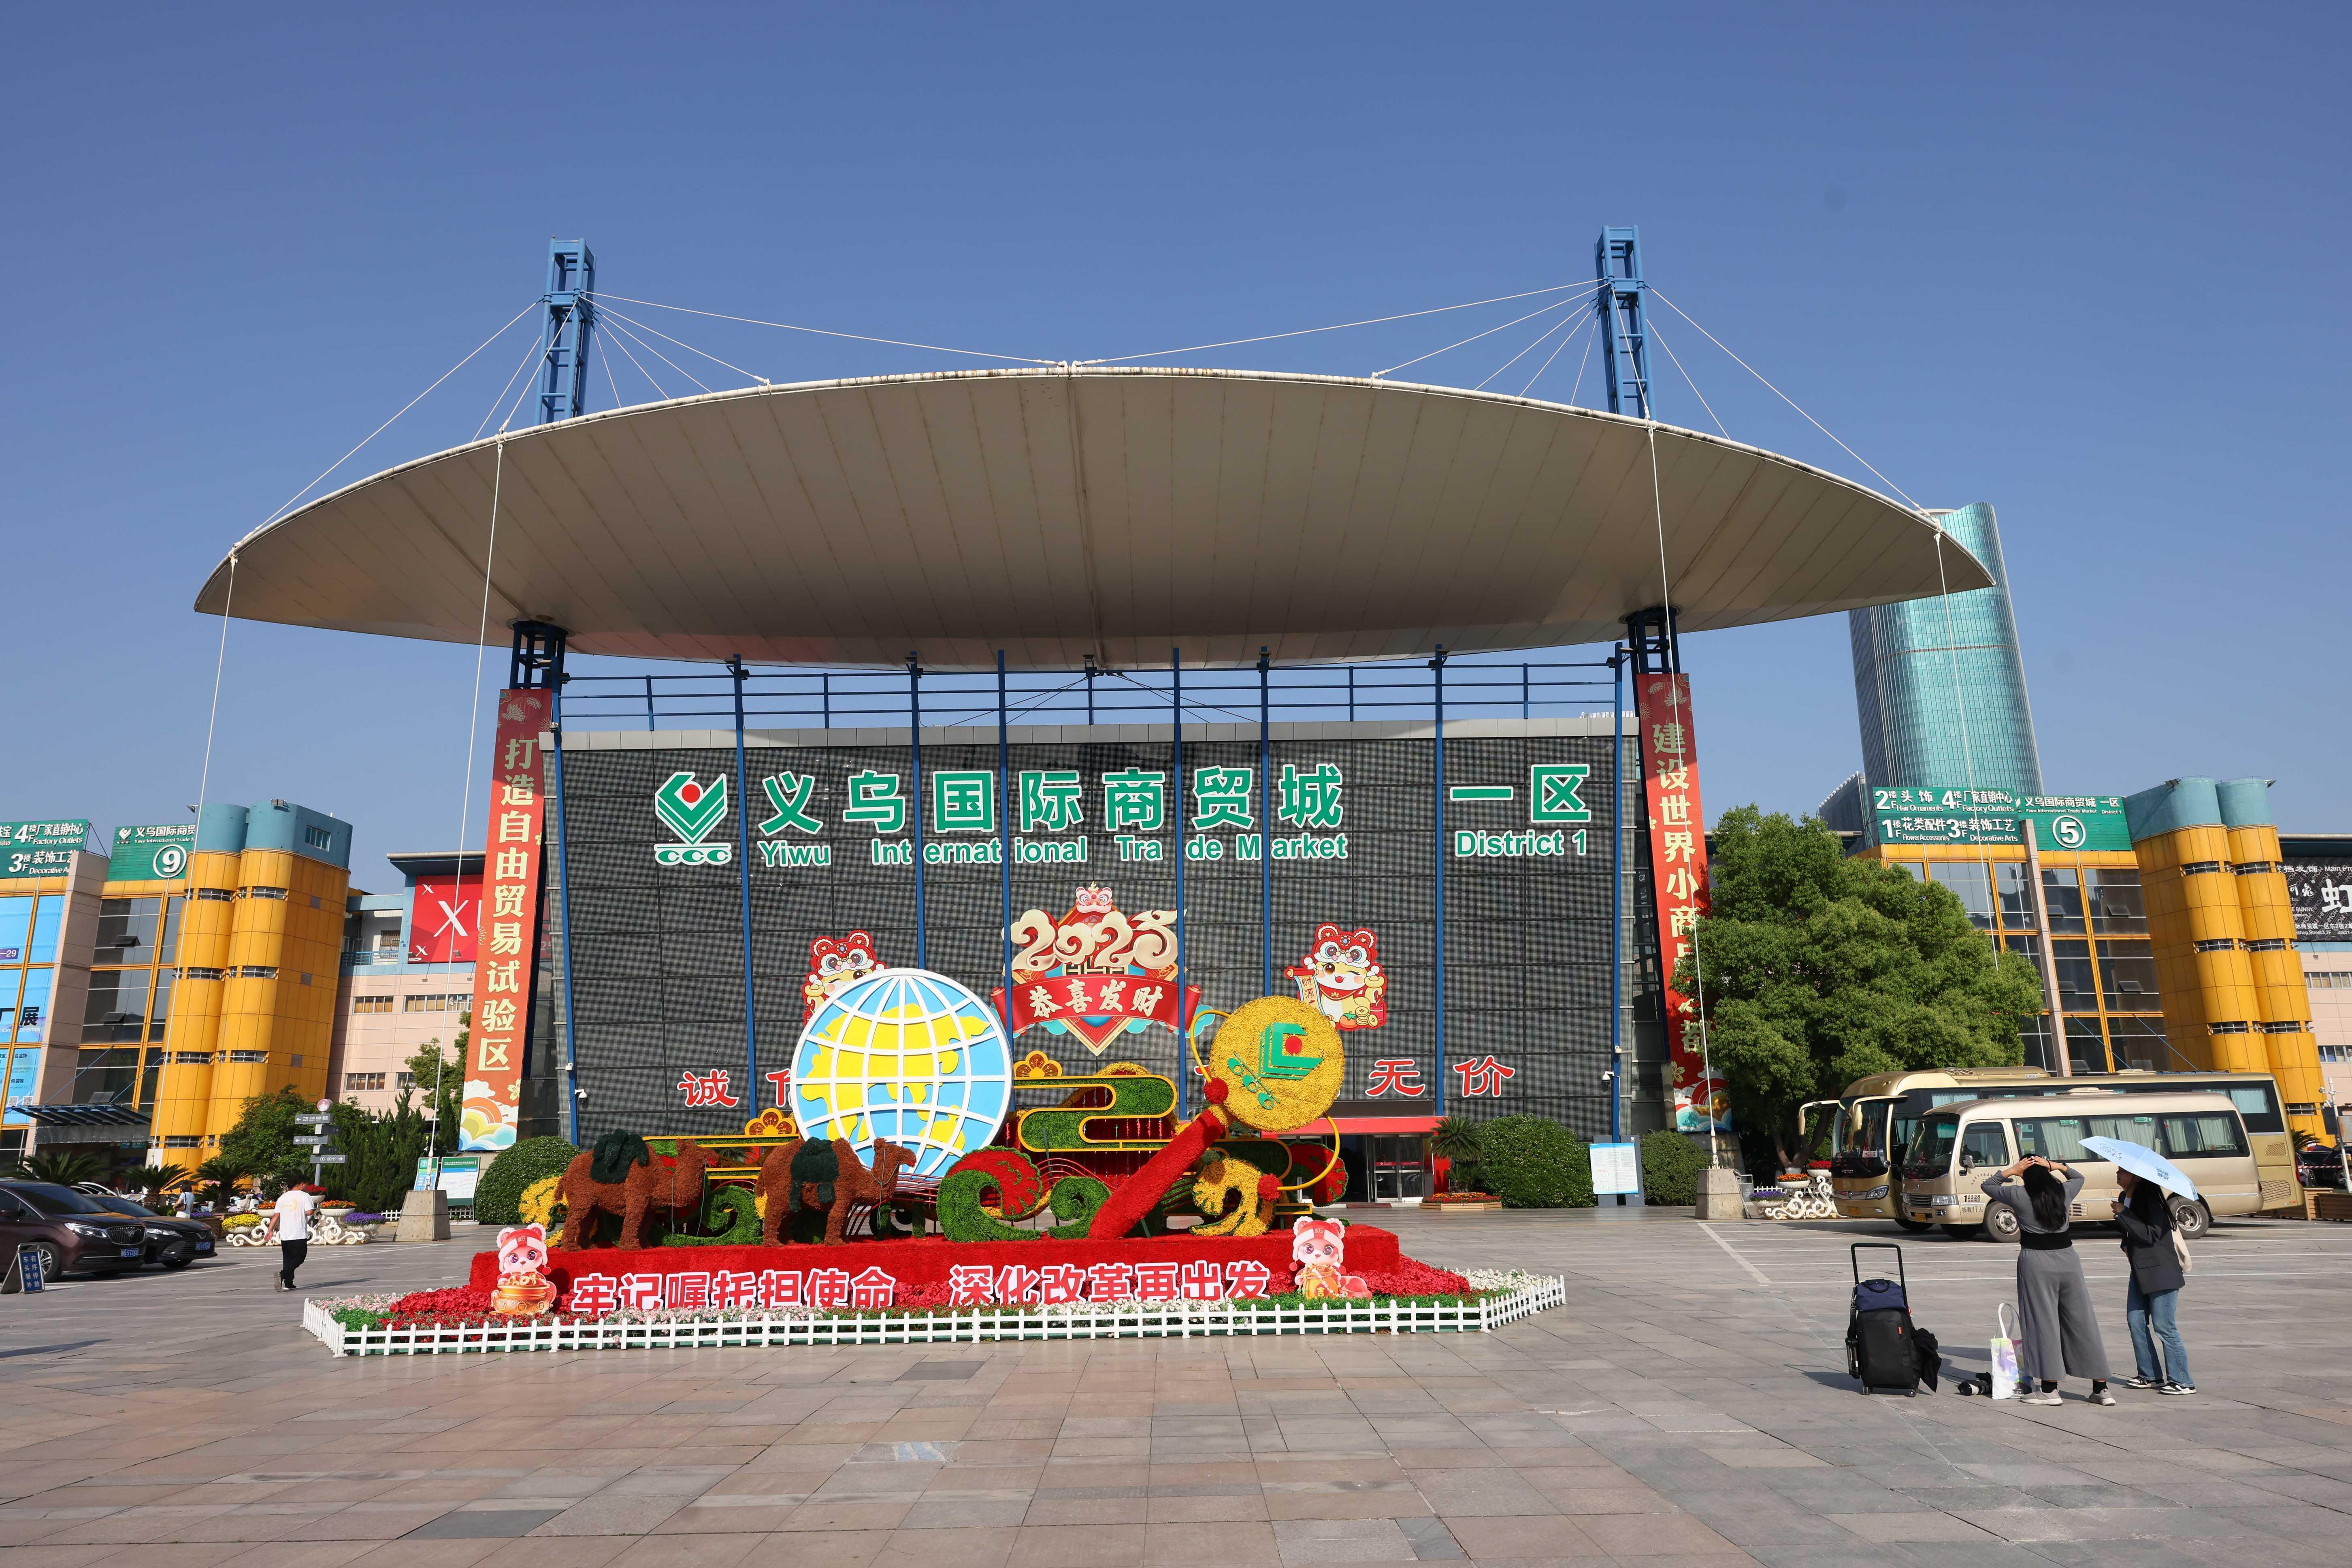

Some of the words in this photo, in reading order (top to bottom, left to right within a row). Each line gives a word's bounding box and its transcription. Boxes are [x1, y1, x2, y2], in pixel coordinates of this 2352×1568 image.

[758, 764, 1343, 837] 义乌国际商贸城
[1450, 764, 1591, 823] 一区
[1962, 805, 1987, 813] Factory
[1964, 790, 2013, 803] 厂家直销中心
[2025, 797, 2096, 807] 义乌国际商贸城
[2100, 798, 2120, 807] 一区
[36, 822, 83, 836] 厂家直销中心
[1901, 817, 1947, 831] 花类配件
[1969, 818, 2015, 831] 装饰工艺
[2060, 821, 2079, 844] 5
[162, 850, 181, 873] 9
[757, 840, 831, 867] Yiwu
[1455, 829, 1564, 857] District
[1572, 829, 1586, 856] 1
[478, 738, 539, 1072] 打造自由贸易试验区
[1652, 723, 1713, 1054] 建设世界小商都
[1001, 909, 1187, 971] 2025
[1029, 979, 1163, 1018] 恭喜发财
[1365, 1055, 1515, 1098] 无价
[31, 1255, 40, 1287] 有序停放
[948, 1260, 1270, 1307] 深化改革再出发
[571, 1266, 897, 1314] 牢记嘱托担使命
